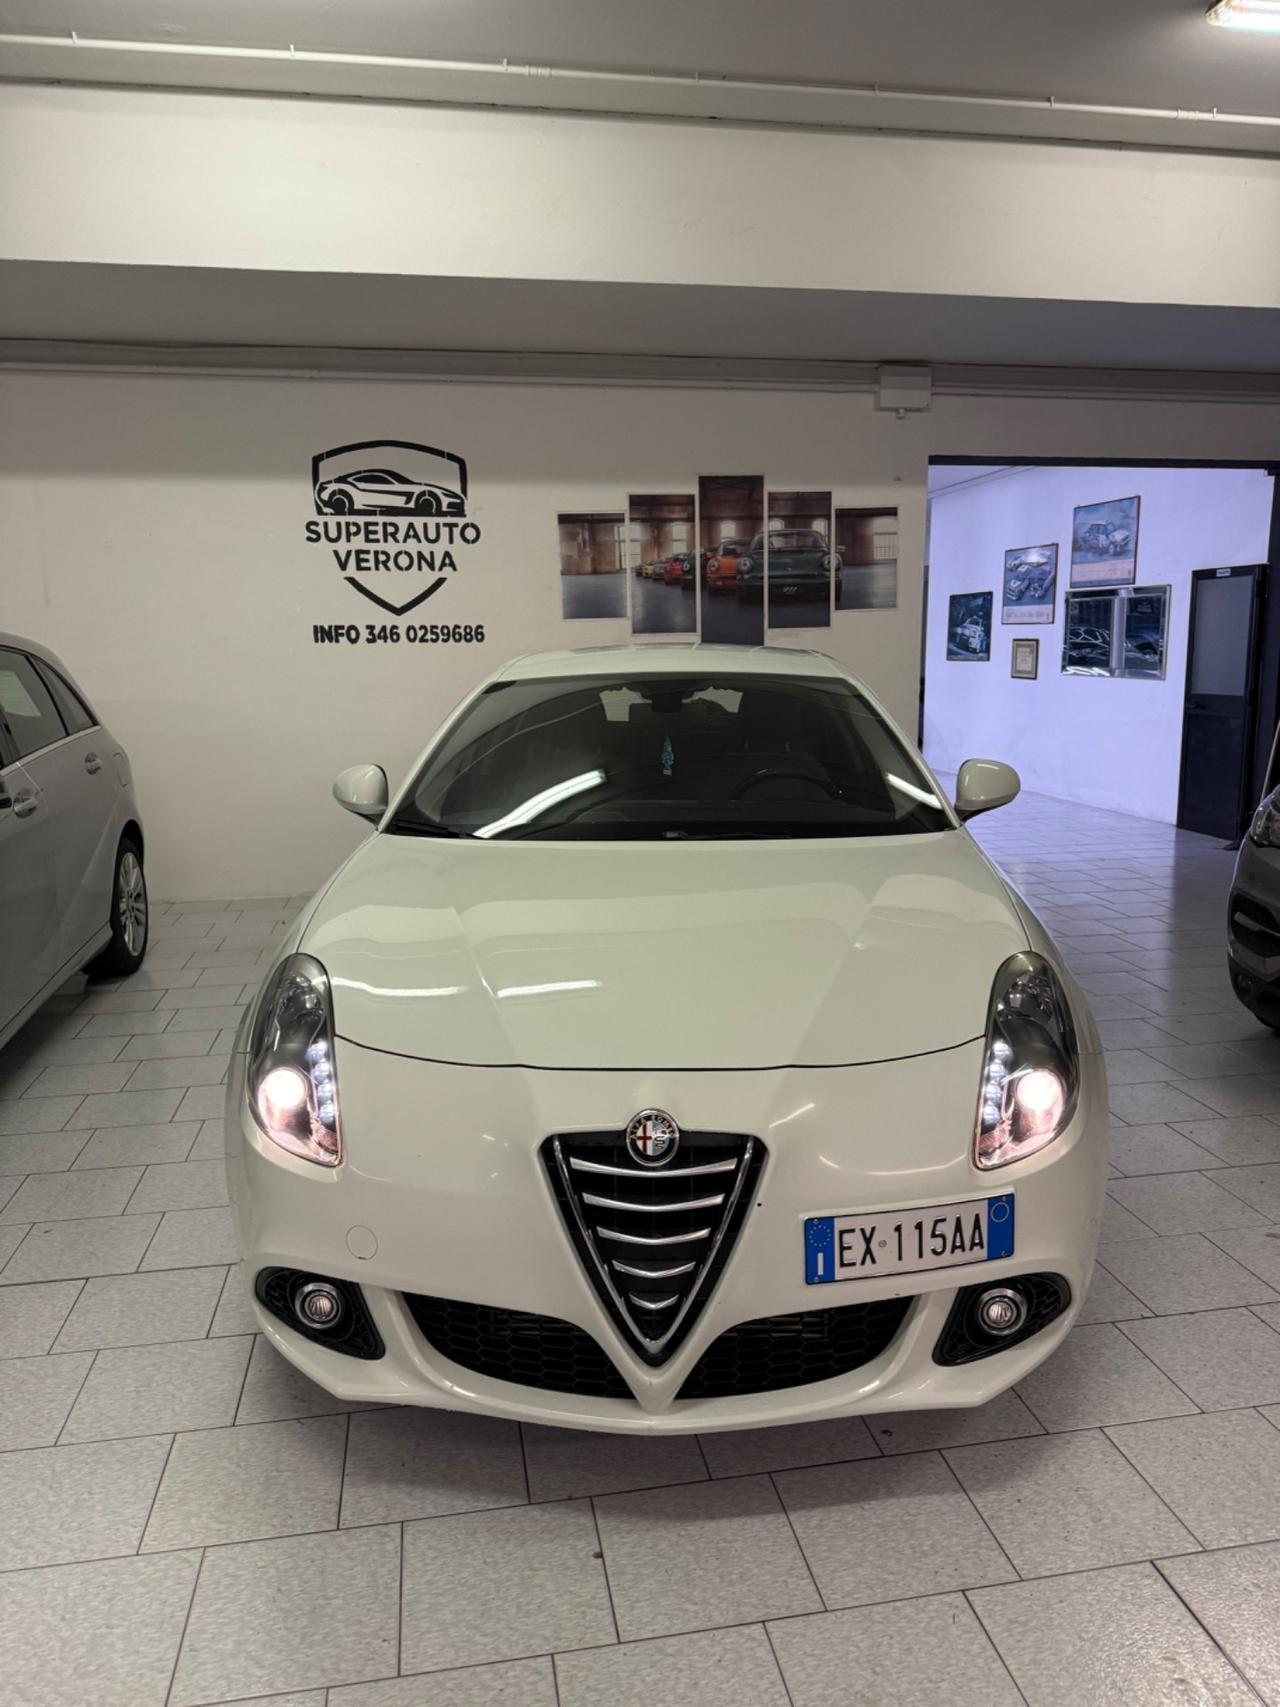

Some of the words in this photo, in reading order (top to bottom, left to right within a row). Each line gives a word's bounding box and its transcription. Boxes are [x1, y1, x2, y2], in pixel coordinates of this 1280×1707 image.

[305, 521, 481, 544] SUPERAUTO
[333, 550, 457, 571] VERONA
[313, 625, 360, 644] INFO
[365, 625, 400, 644] 346
[405, 625, 485, 643] 0259686
[838, 1226, 877, 1268] EX
[894, 1213, 984, 1261] 115AA
